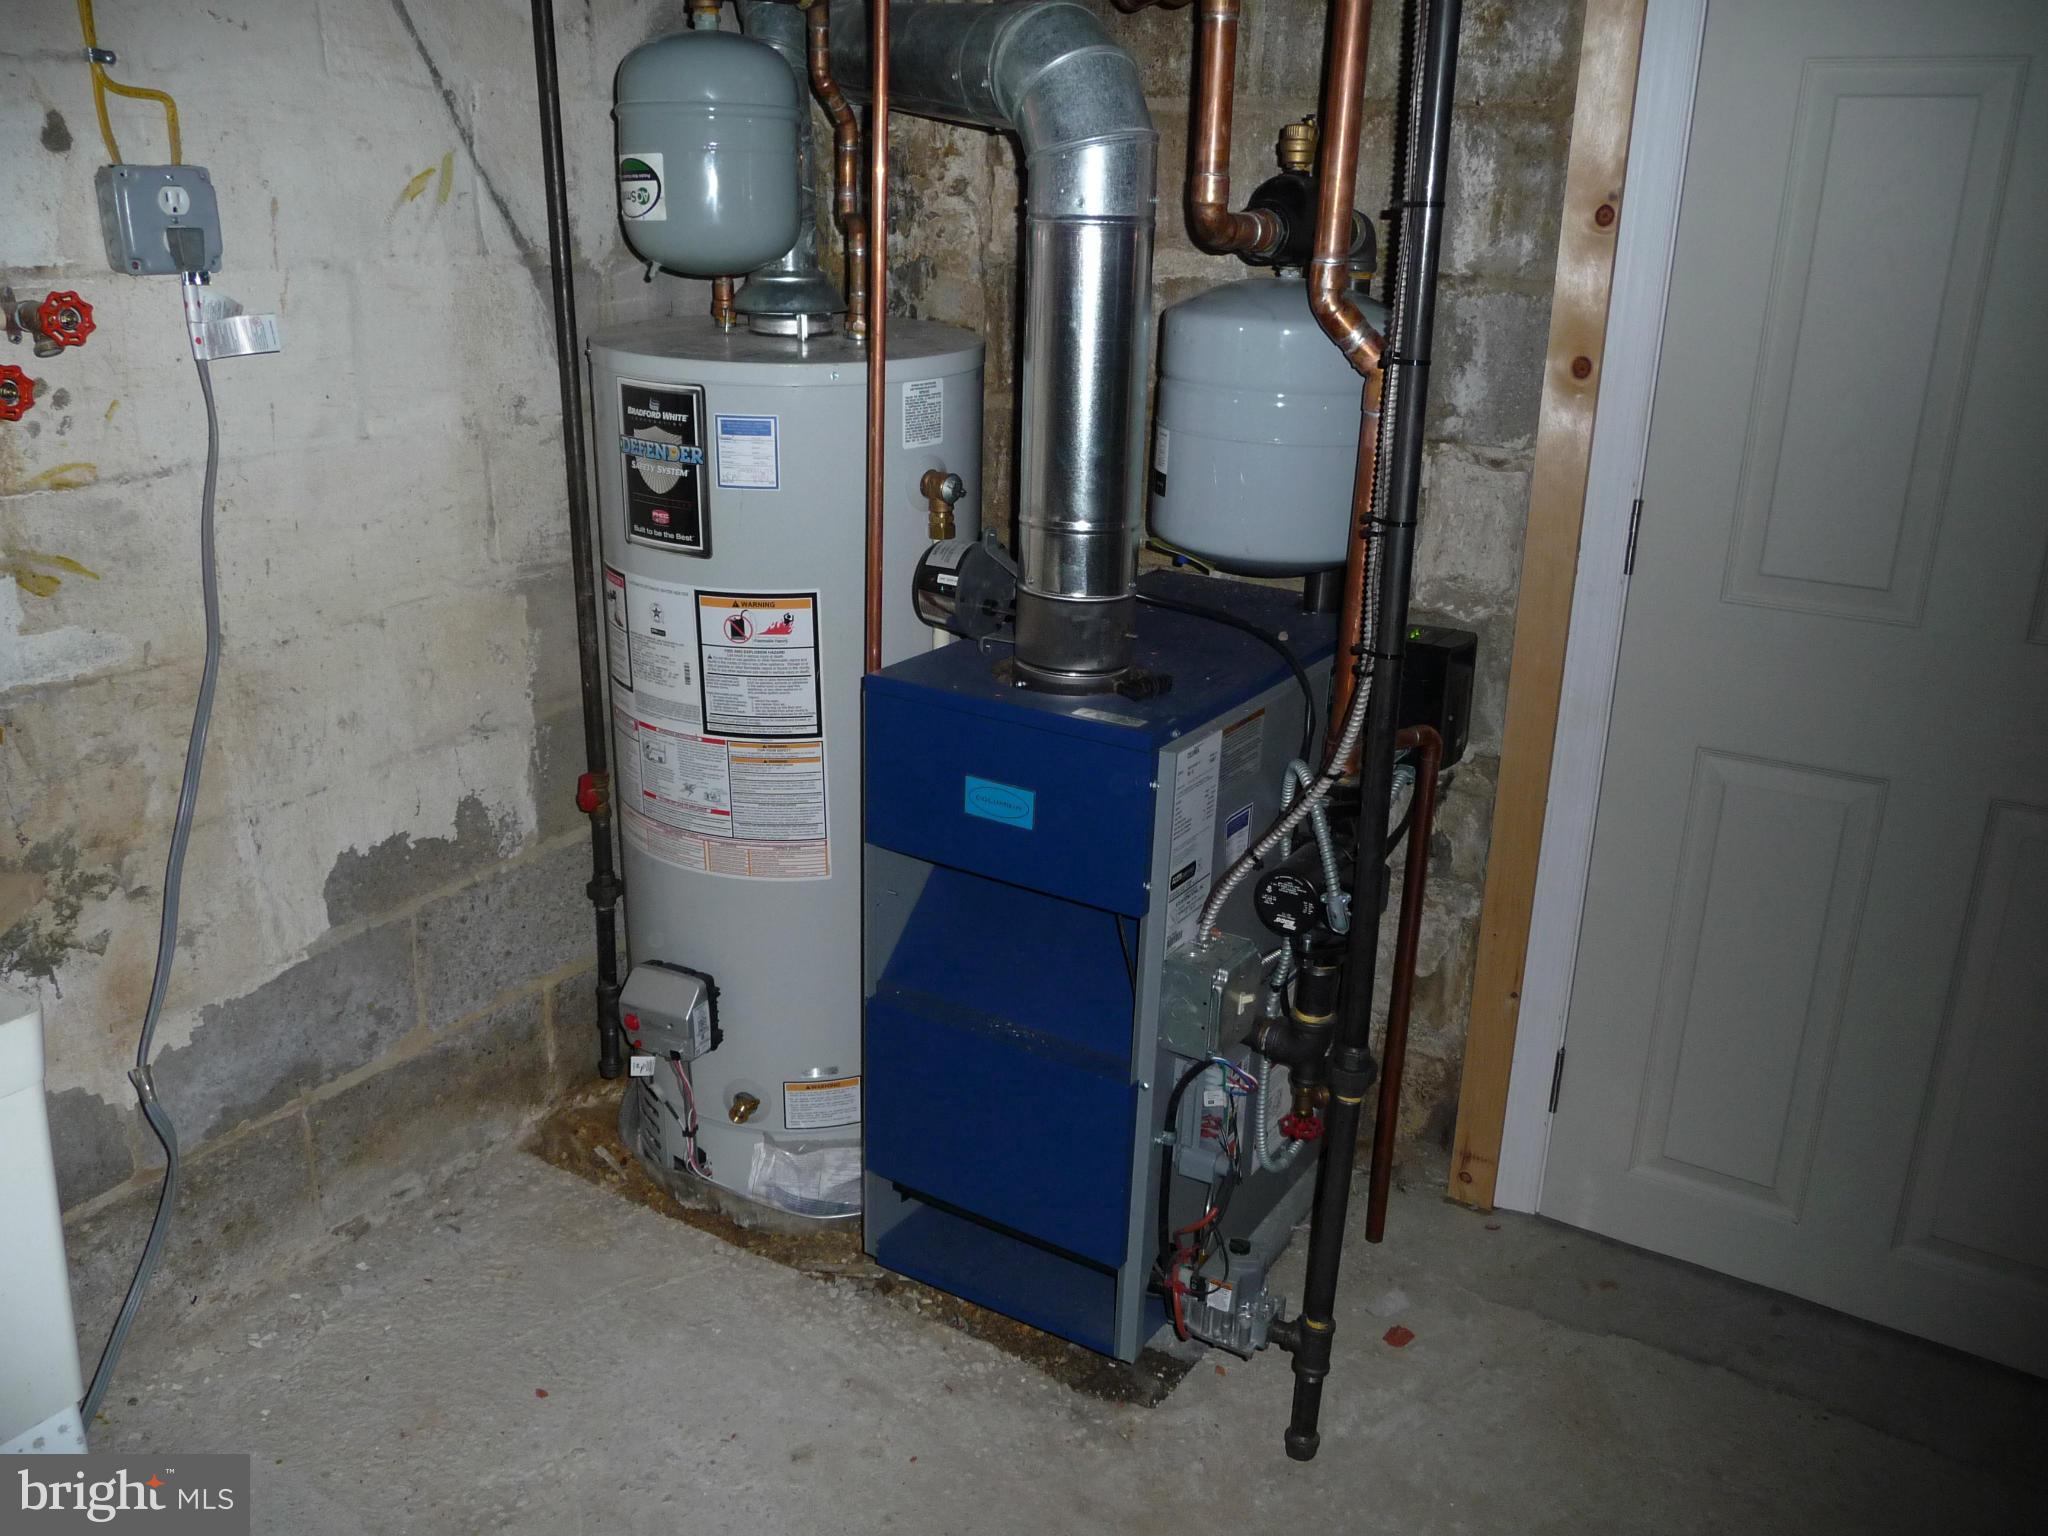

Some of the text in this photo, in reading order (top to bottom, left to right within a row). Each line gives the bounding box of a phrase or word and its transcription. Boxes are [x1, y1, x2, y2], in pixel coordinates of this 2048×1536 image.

[627, 406, 661, 419] BRADFORD
[662, 411, 688, 422] WHITE
[620, 435, 704, 465] DEFENDER
[657, 465, 689, 478] SYSTEM
[675, 533, 693, 542] Best
[741, 600, 776, 608] WARNING
